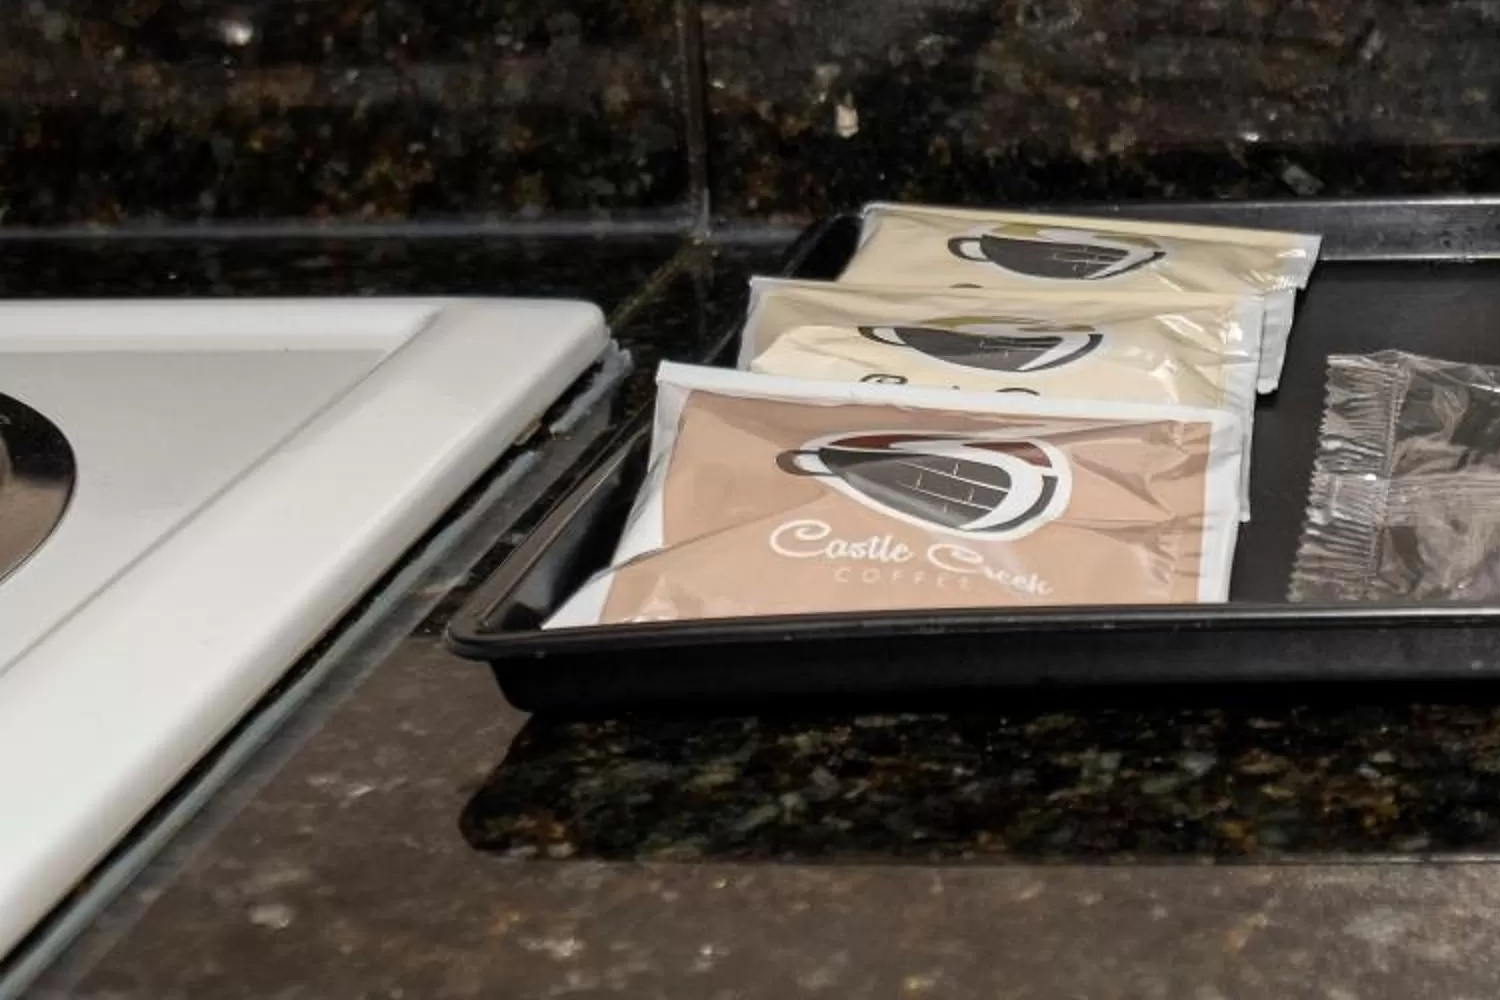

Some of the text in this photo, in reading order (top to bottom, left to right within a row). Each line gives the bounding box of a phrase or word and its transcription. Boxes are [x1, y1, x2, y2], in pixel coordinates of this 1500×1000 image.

[769, 518, 1053, 597] Castle Creek
[833, 566, 974, 593] COFFEE
